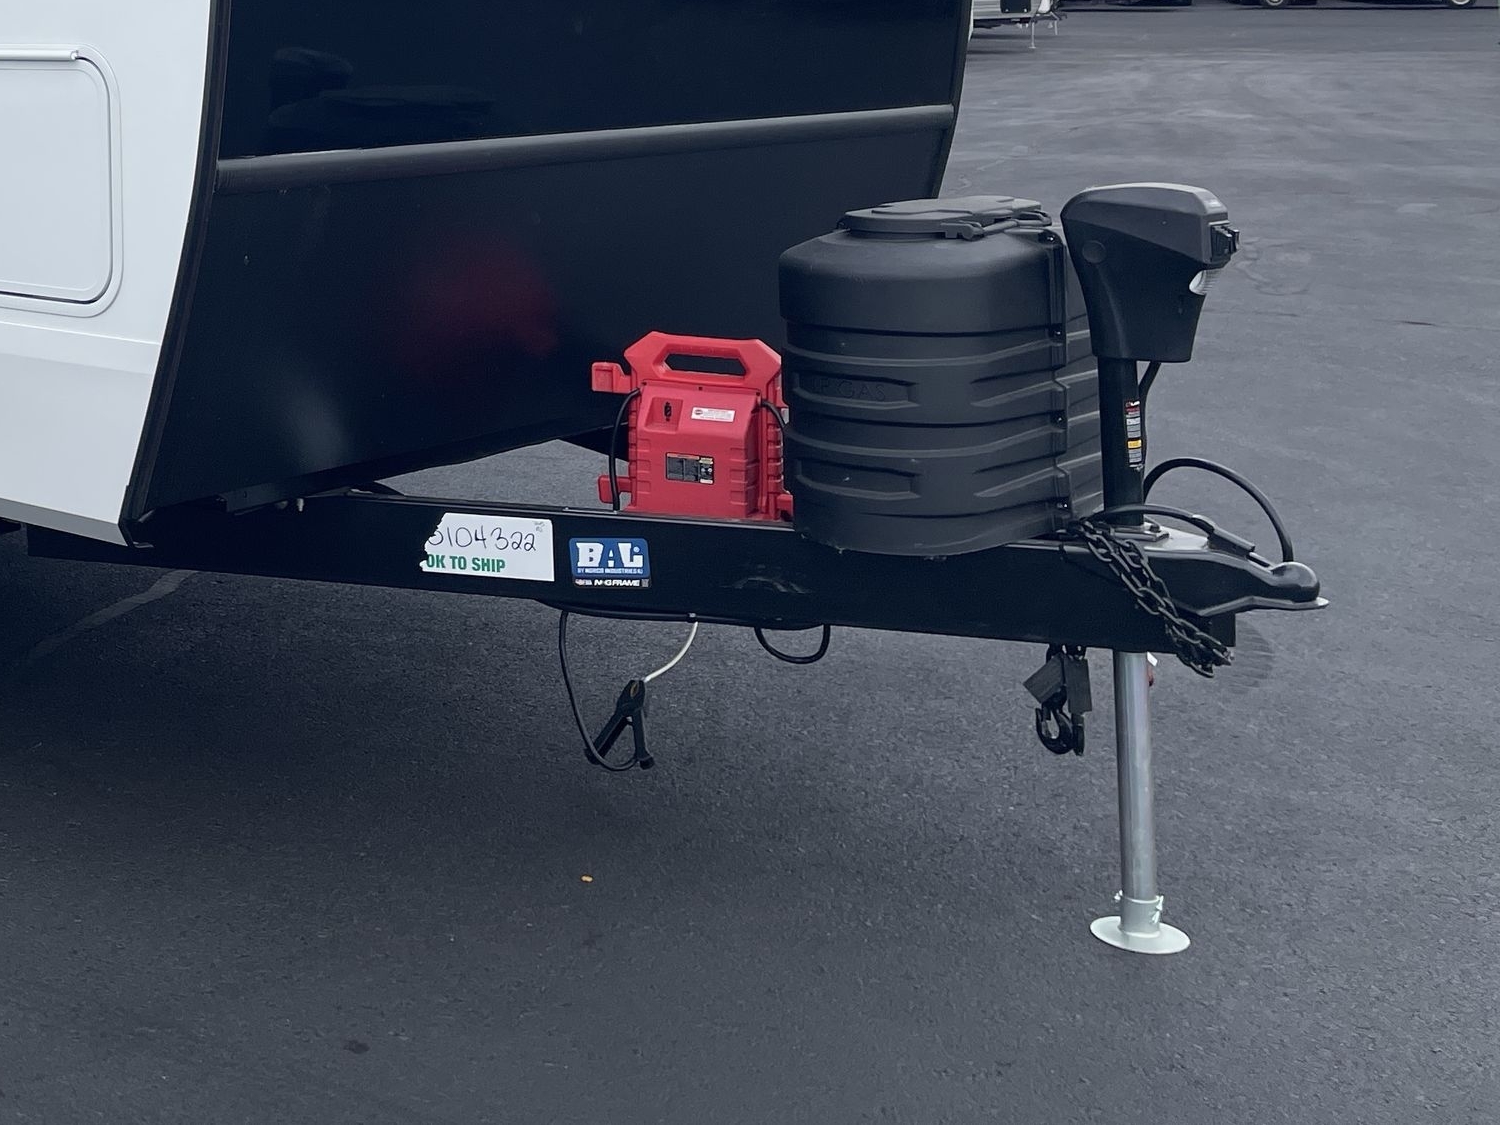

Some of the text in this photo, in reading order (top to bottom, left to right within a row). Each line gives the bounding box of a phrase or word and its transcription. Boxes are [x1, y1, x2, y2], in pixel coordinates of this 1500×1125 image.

[426, 553, 506, 573] OK TO SHIP
